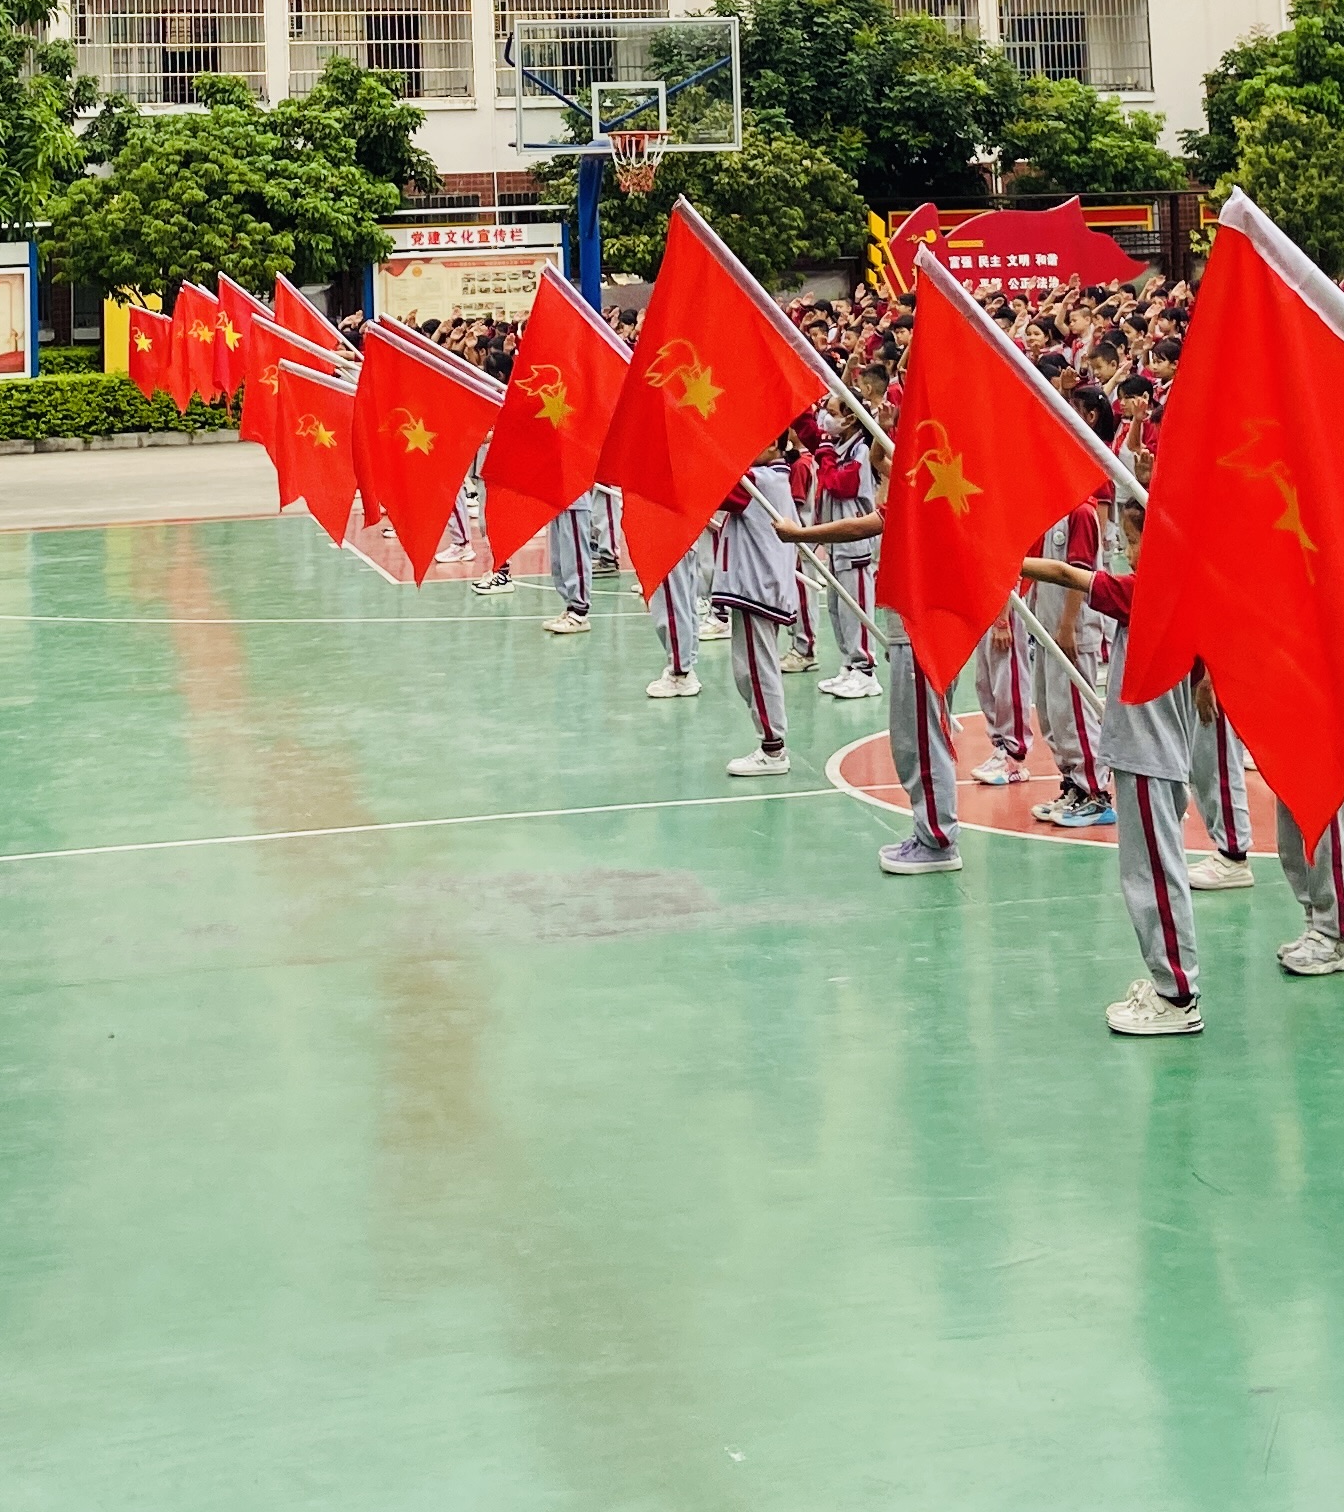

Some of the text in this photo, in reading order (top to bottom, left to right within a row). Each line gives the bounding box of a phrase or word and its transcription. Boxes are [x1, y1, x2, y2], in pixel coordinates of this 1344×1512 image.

[411, 228, 523, 246] 党建文化宣传栏
[949, 253, 1059, 269] 富强 民主 文明 和谐
